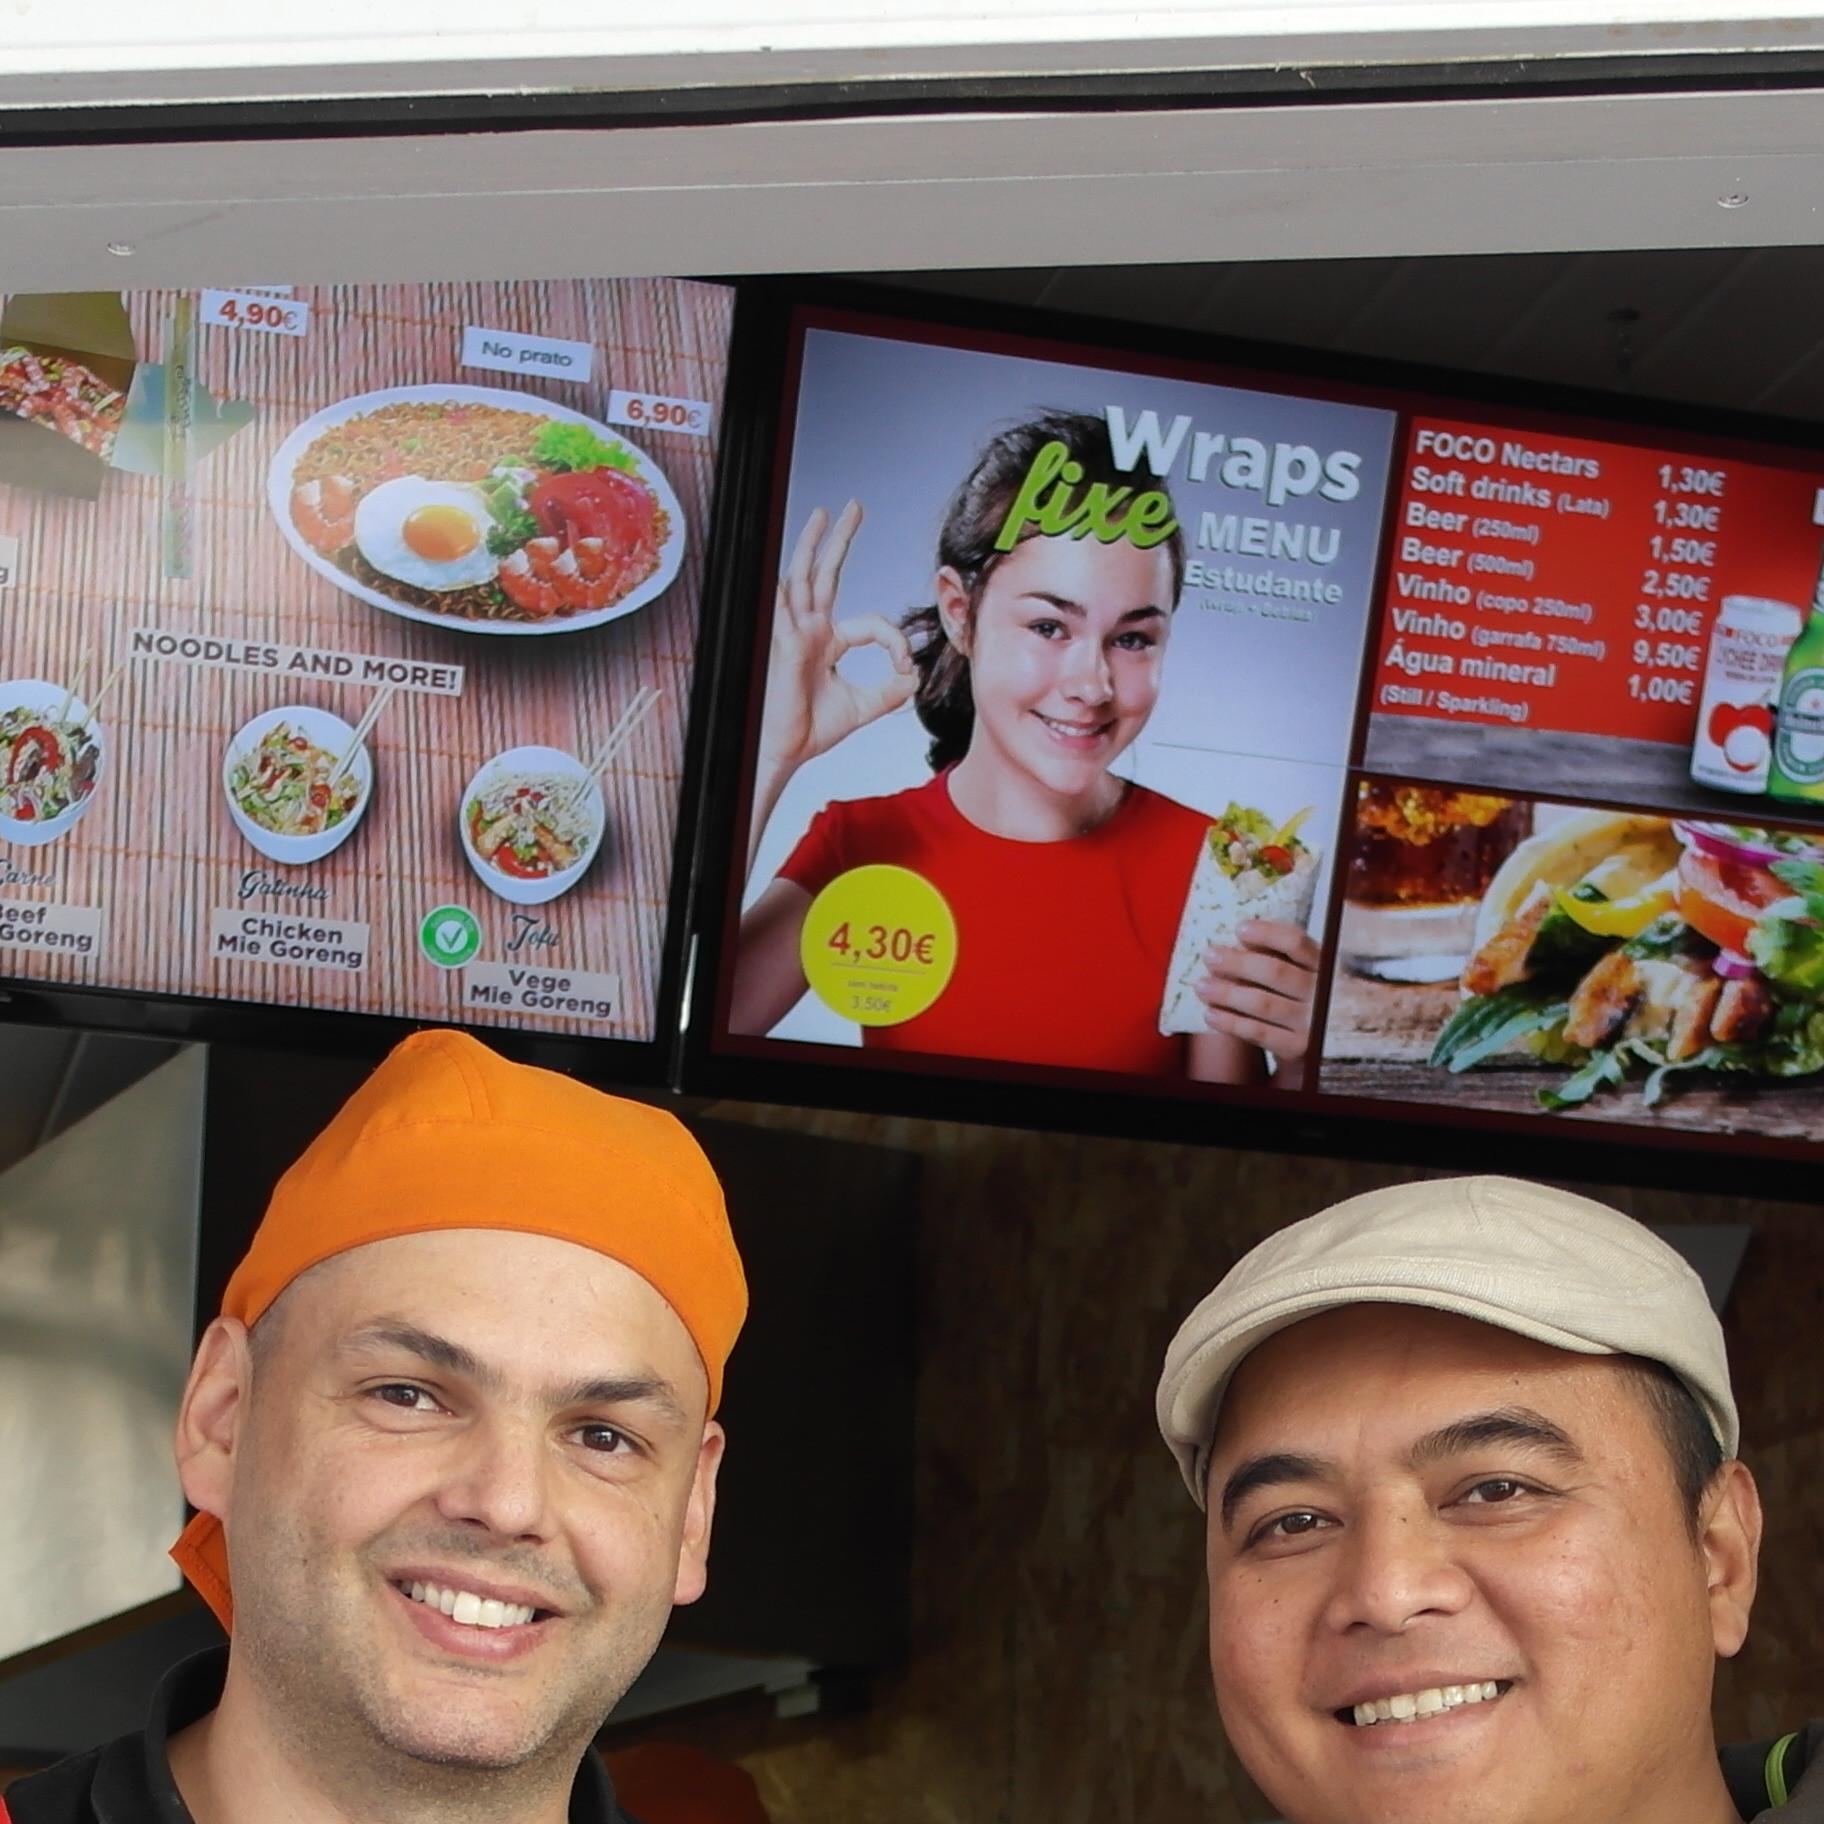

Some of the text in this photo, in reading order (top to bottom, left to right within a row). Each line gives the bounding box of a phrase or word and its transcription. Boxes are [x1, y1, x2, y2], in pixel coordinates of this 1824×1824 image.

[219, 300, 300, 331] 4,90€
[482, 341, 573, 368] No prato
[627, 399, 701, 428] 6,90€
[1105, 405, 1363, 505] Wraps
[1416, 430, 1725, 497] FOCO Nectars 1,30€
[994, 440, 1179, 551] fixe
[1411, 466, 1721, 532] Soft drinks (Lata) 1,30€
[1197, 511, 1341, 565] MENU
[1406, 502, 1716, 566] Beer (250ml) 1,50€
[1183, 559, 1343, 604] Estudante
[1401, 537, 1711, 601] Beer (500ml) 2,50€
[1397, 572, 1703, 636] Vinho (copo 250ml) 3,00€
[132, 631, 459, 691] NOODLES AND MORE!
[1392, 608, 1466, 640] Vinho
[1471, 625, 1541, 649] (garrafa
[1547, 634, 1606, 661] 750ml)
[1633, 640, 1701, 670] 9,50€
[1385, 638, 1454, 676] Água
[1460, 656, 1557, 687] mineral
[1628, 674, 1694, 705] 1,00€
[1380, 684, 1423, 705] (Still
[1437, 691, 1529, 722] Sparkling)
[218, 934, 362, 969] Mie Goreng
[242, 917, 343, 945] Chicken
[507, 914, 561, 951] Tofu
[828, 921, 936, 965] 4,30€
[470, 985, 611, 1018] Mie Goreng
[508, 969, 571, 994] Vege
